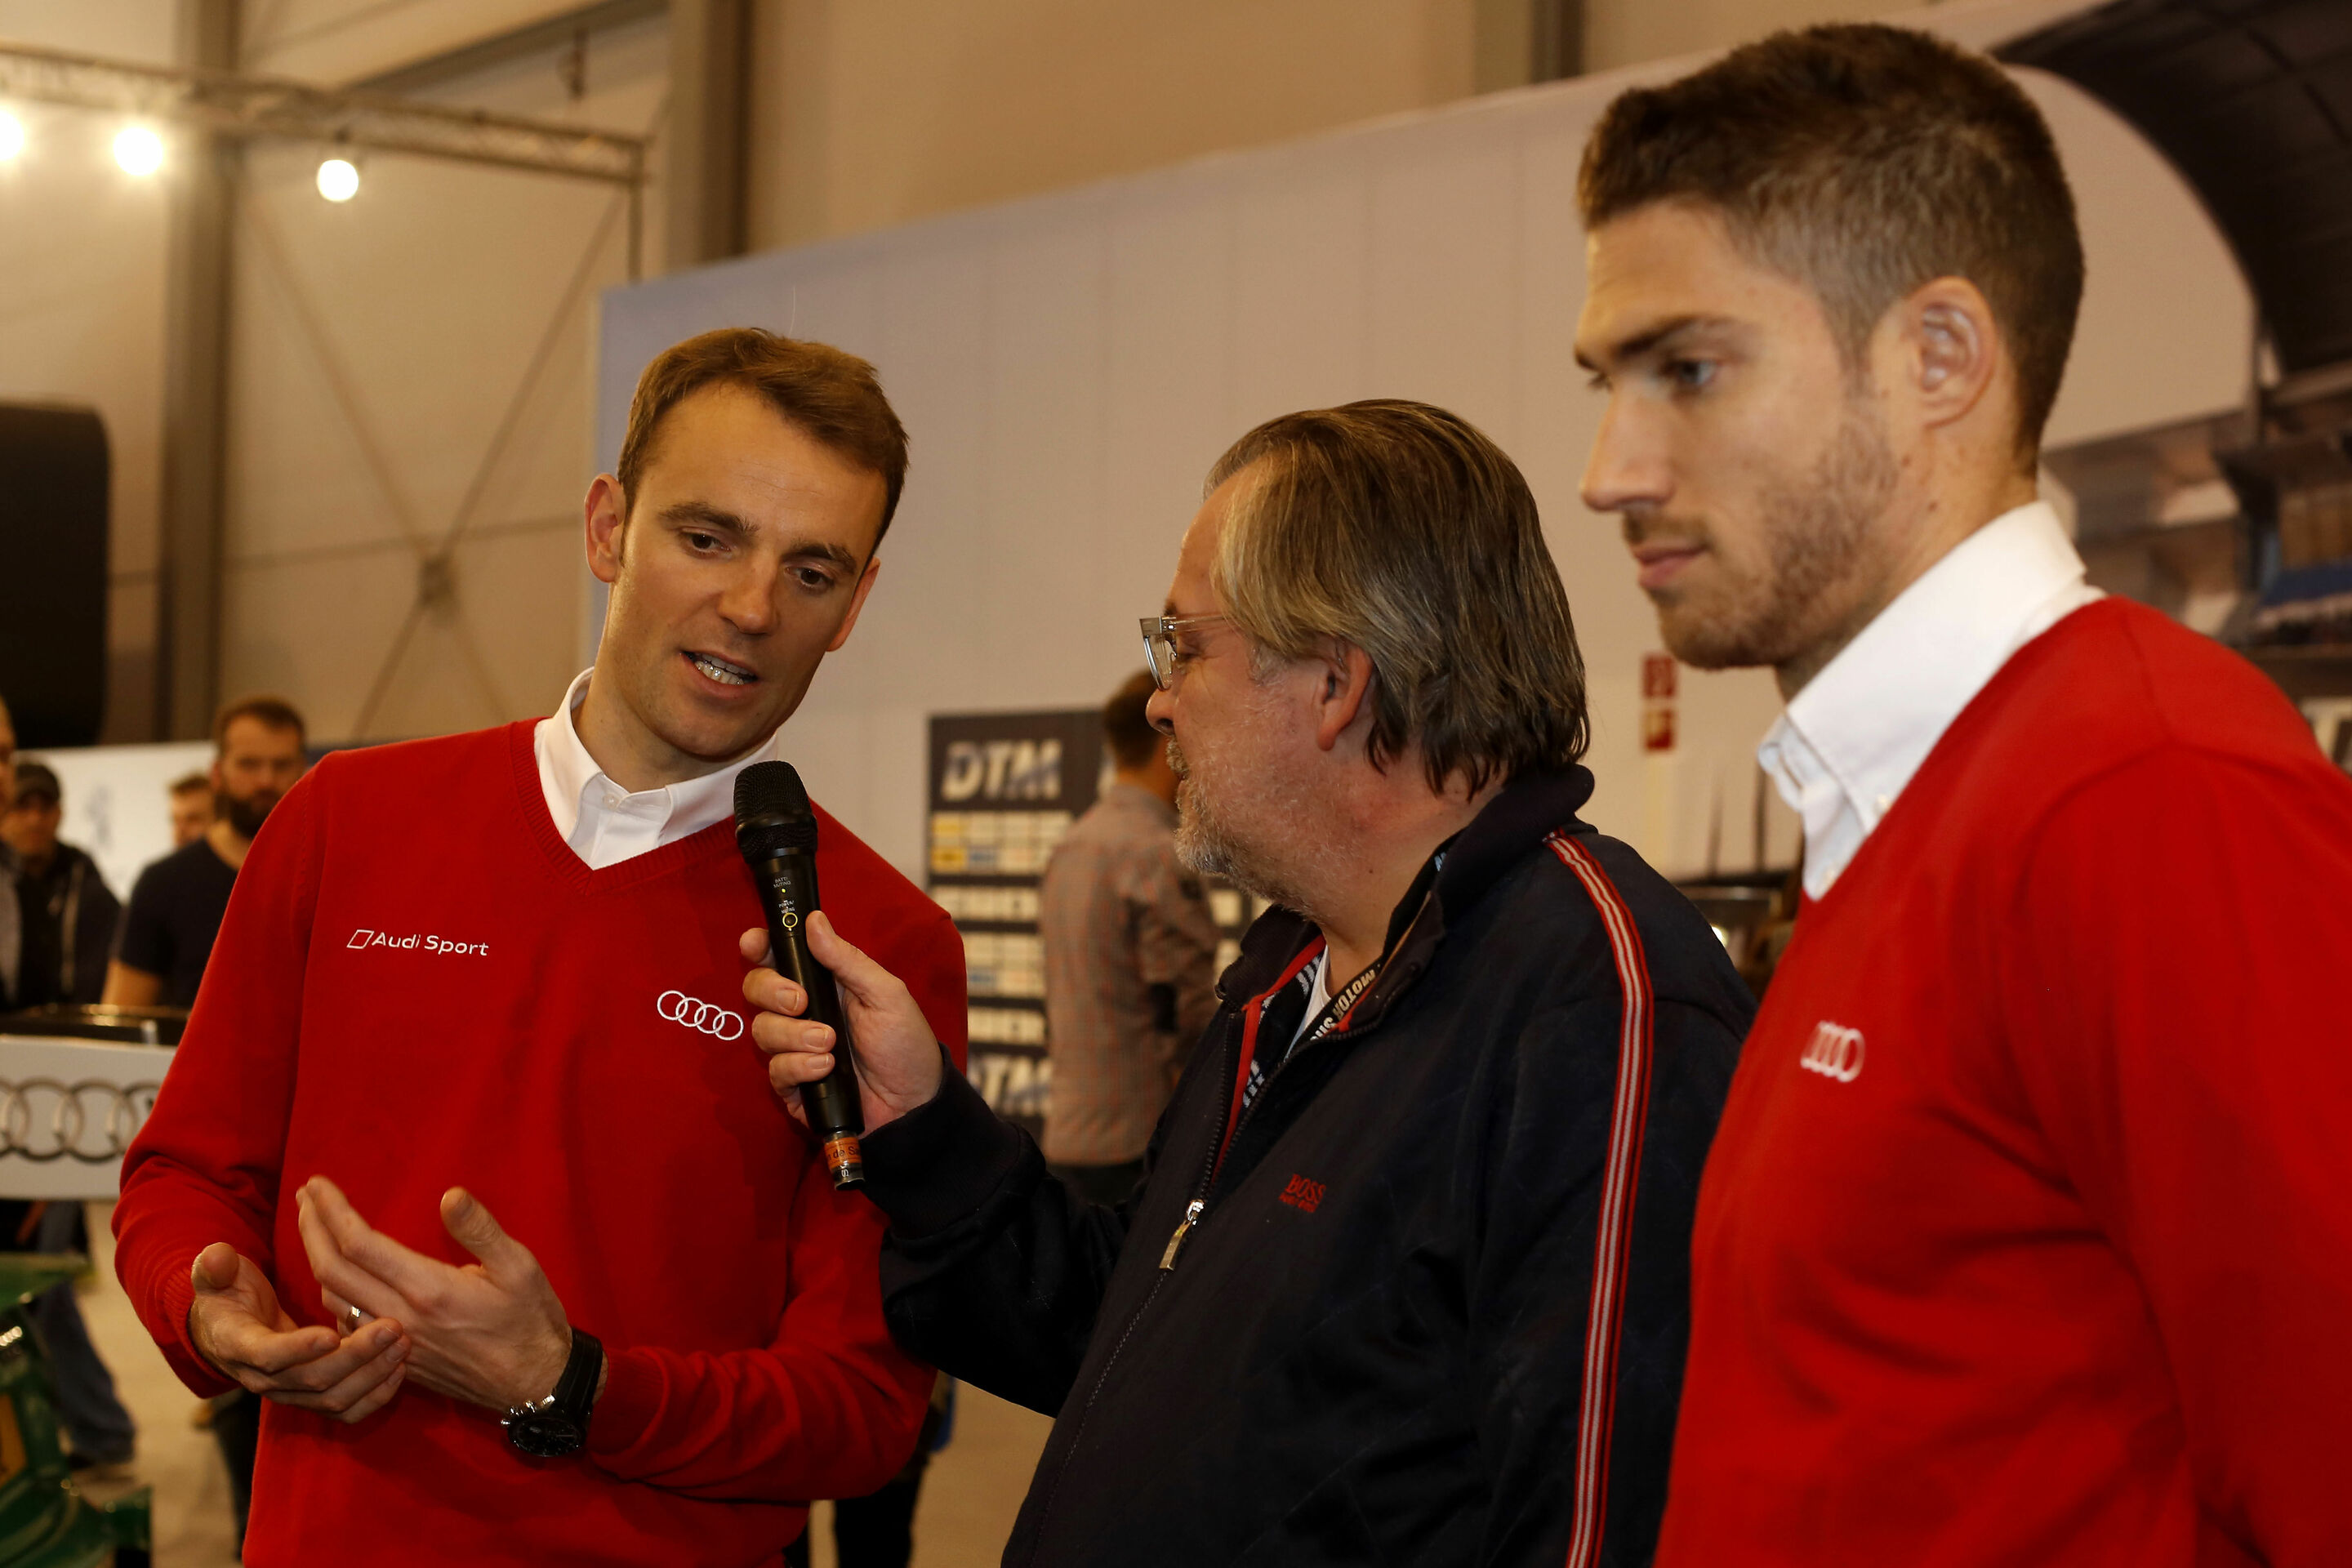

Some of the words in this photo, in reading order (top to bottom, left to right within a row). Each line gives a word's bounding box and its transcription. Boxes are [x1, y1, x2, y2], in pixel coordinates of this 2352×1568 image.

[942, 740, 1062, 801] DTM
[372, 932, 421, 949] Audi
[424, 934, 489, 956] Sport
[1332, 969, 1376, 1021] MOTOR
[1285, 1173, 1327, 1205] BOSS
